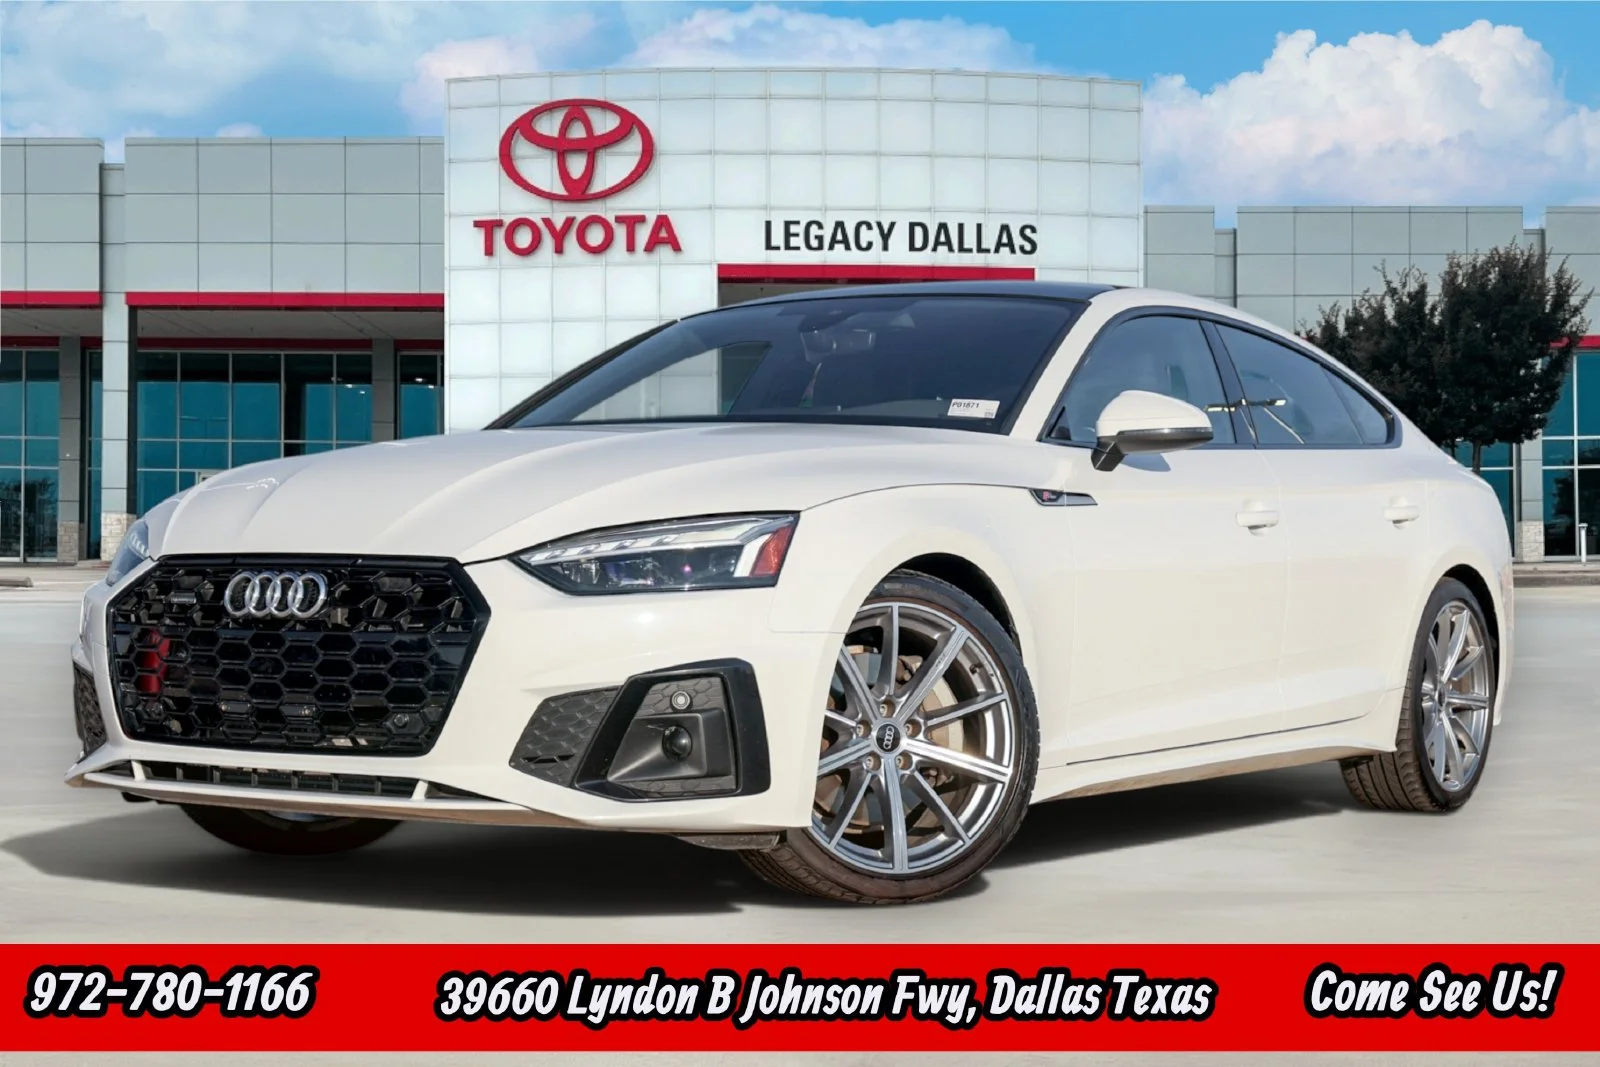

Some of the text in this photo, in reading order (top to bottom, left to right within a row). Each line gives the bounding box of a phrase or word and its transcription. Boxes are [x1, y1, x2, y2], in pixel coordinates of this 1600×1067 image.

[474, 214, 682, 256] TOYOTA
[764, 219, 1039, 256] LEGACY DALLAS
